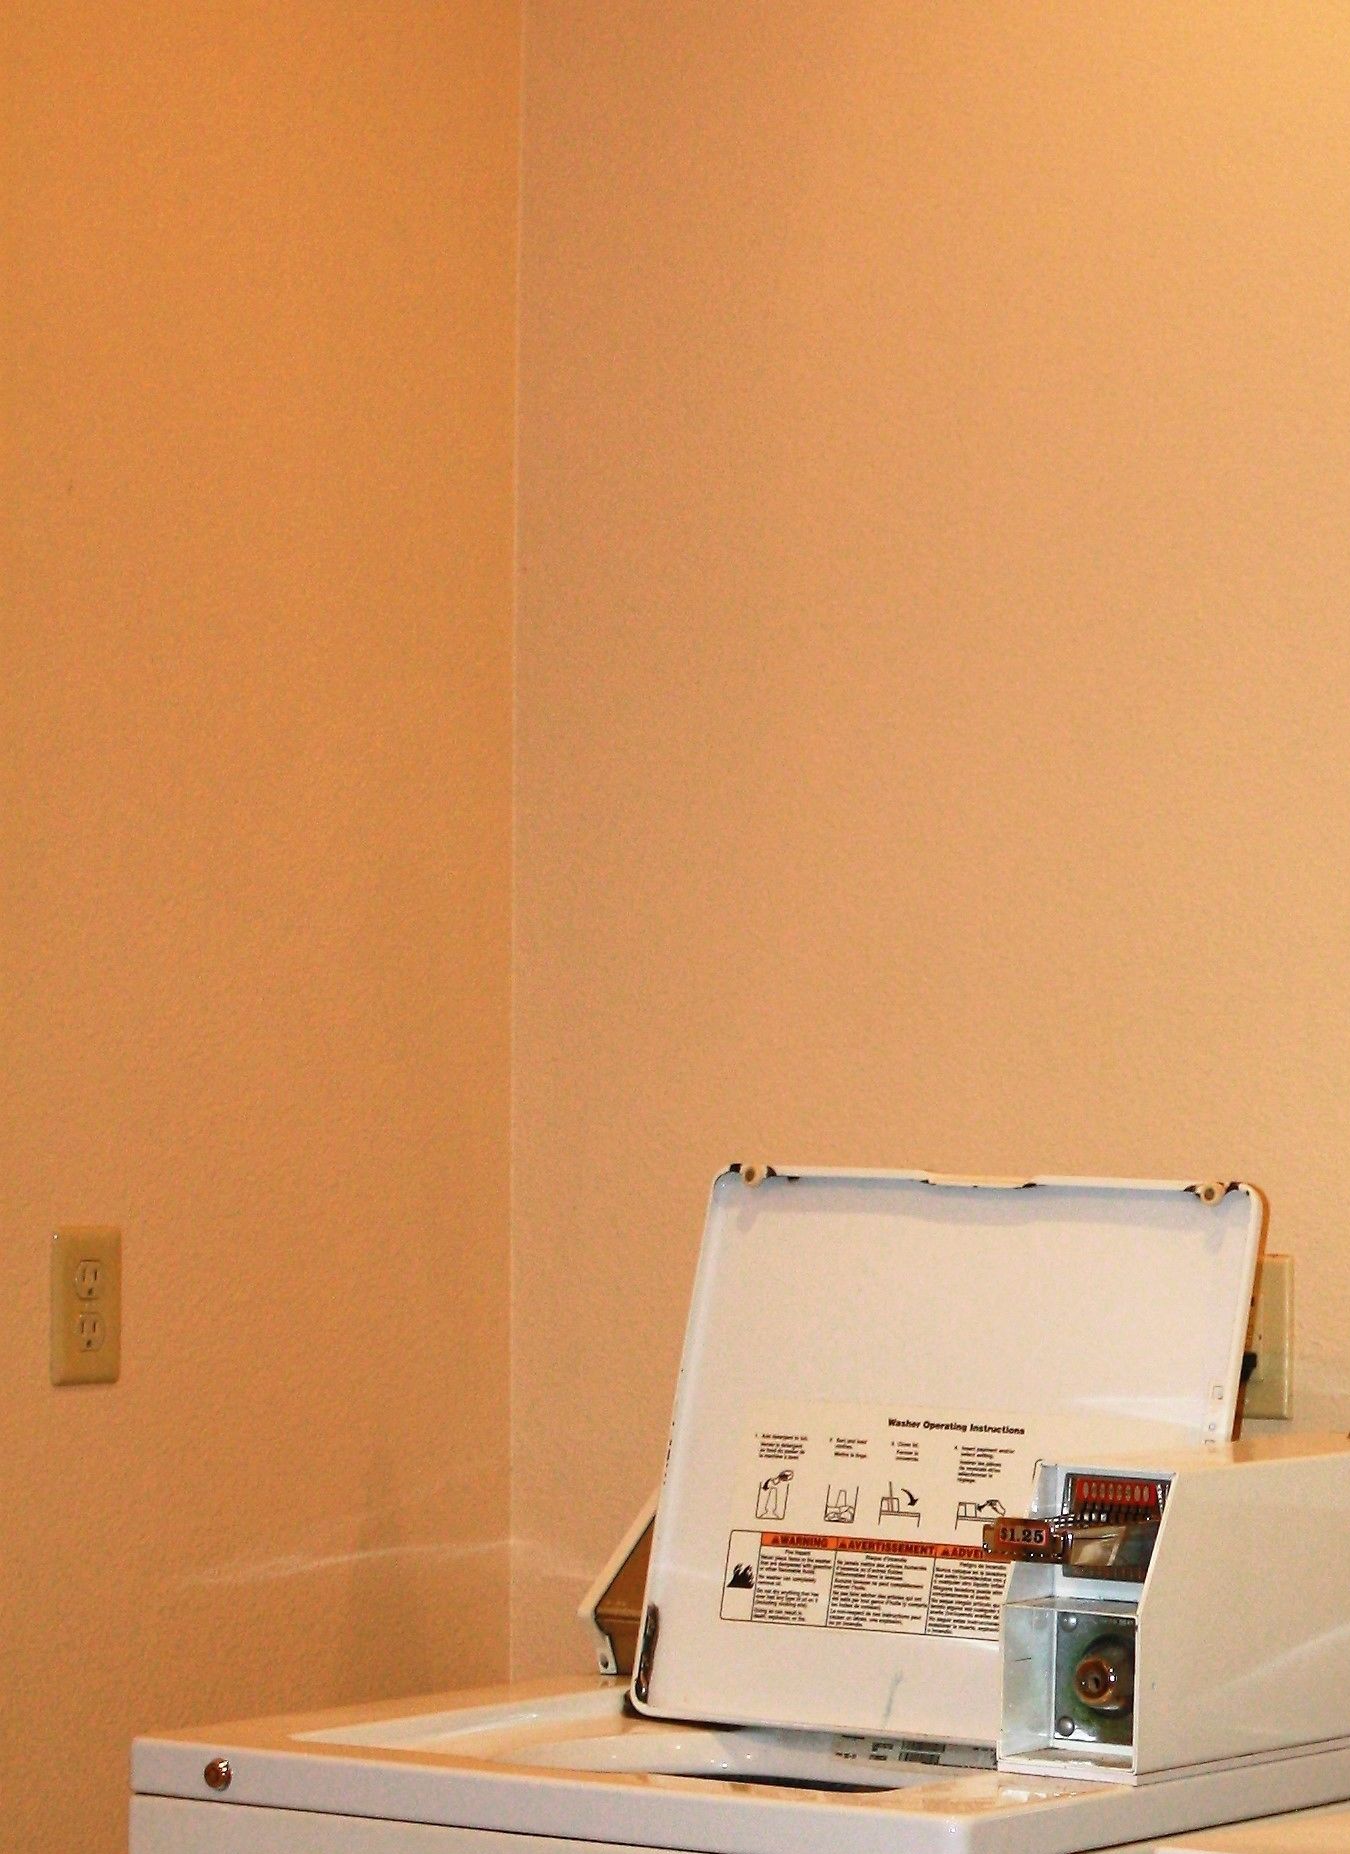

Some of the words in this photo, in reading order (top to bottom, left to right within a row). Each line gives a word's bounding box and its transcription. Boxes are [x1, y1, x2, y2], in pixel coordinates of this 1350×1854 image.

[888, 1418, 921, 1429] Washer
[923, 1421, 967, 1433] Operating
[970, 1423, 1025, 1435] Instructions
[1000, 1523, 1044, 1544] $1.25
[780, 1535, 828, 1548] WARNING
[848, 1540, 933, 1555] AVERTISSEMENT
[950, 1546, 983, 1558] ADVE
